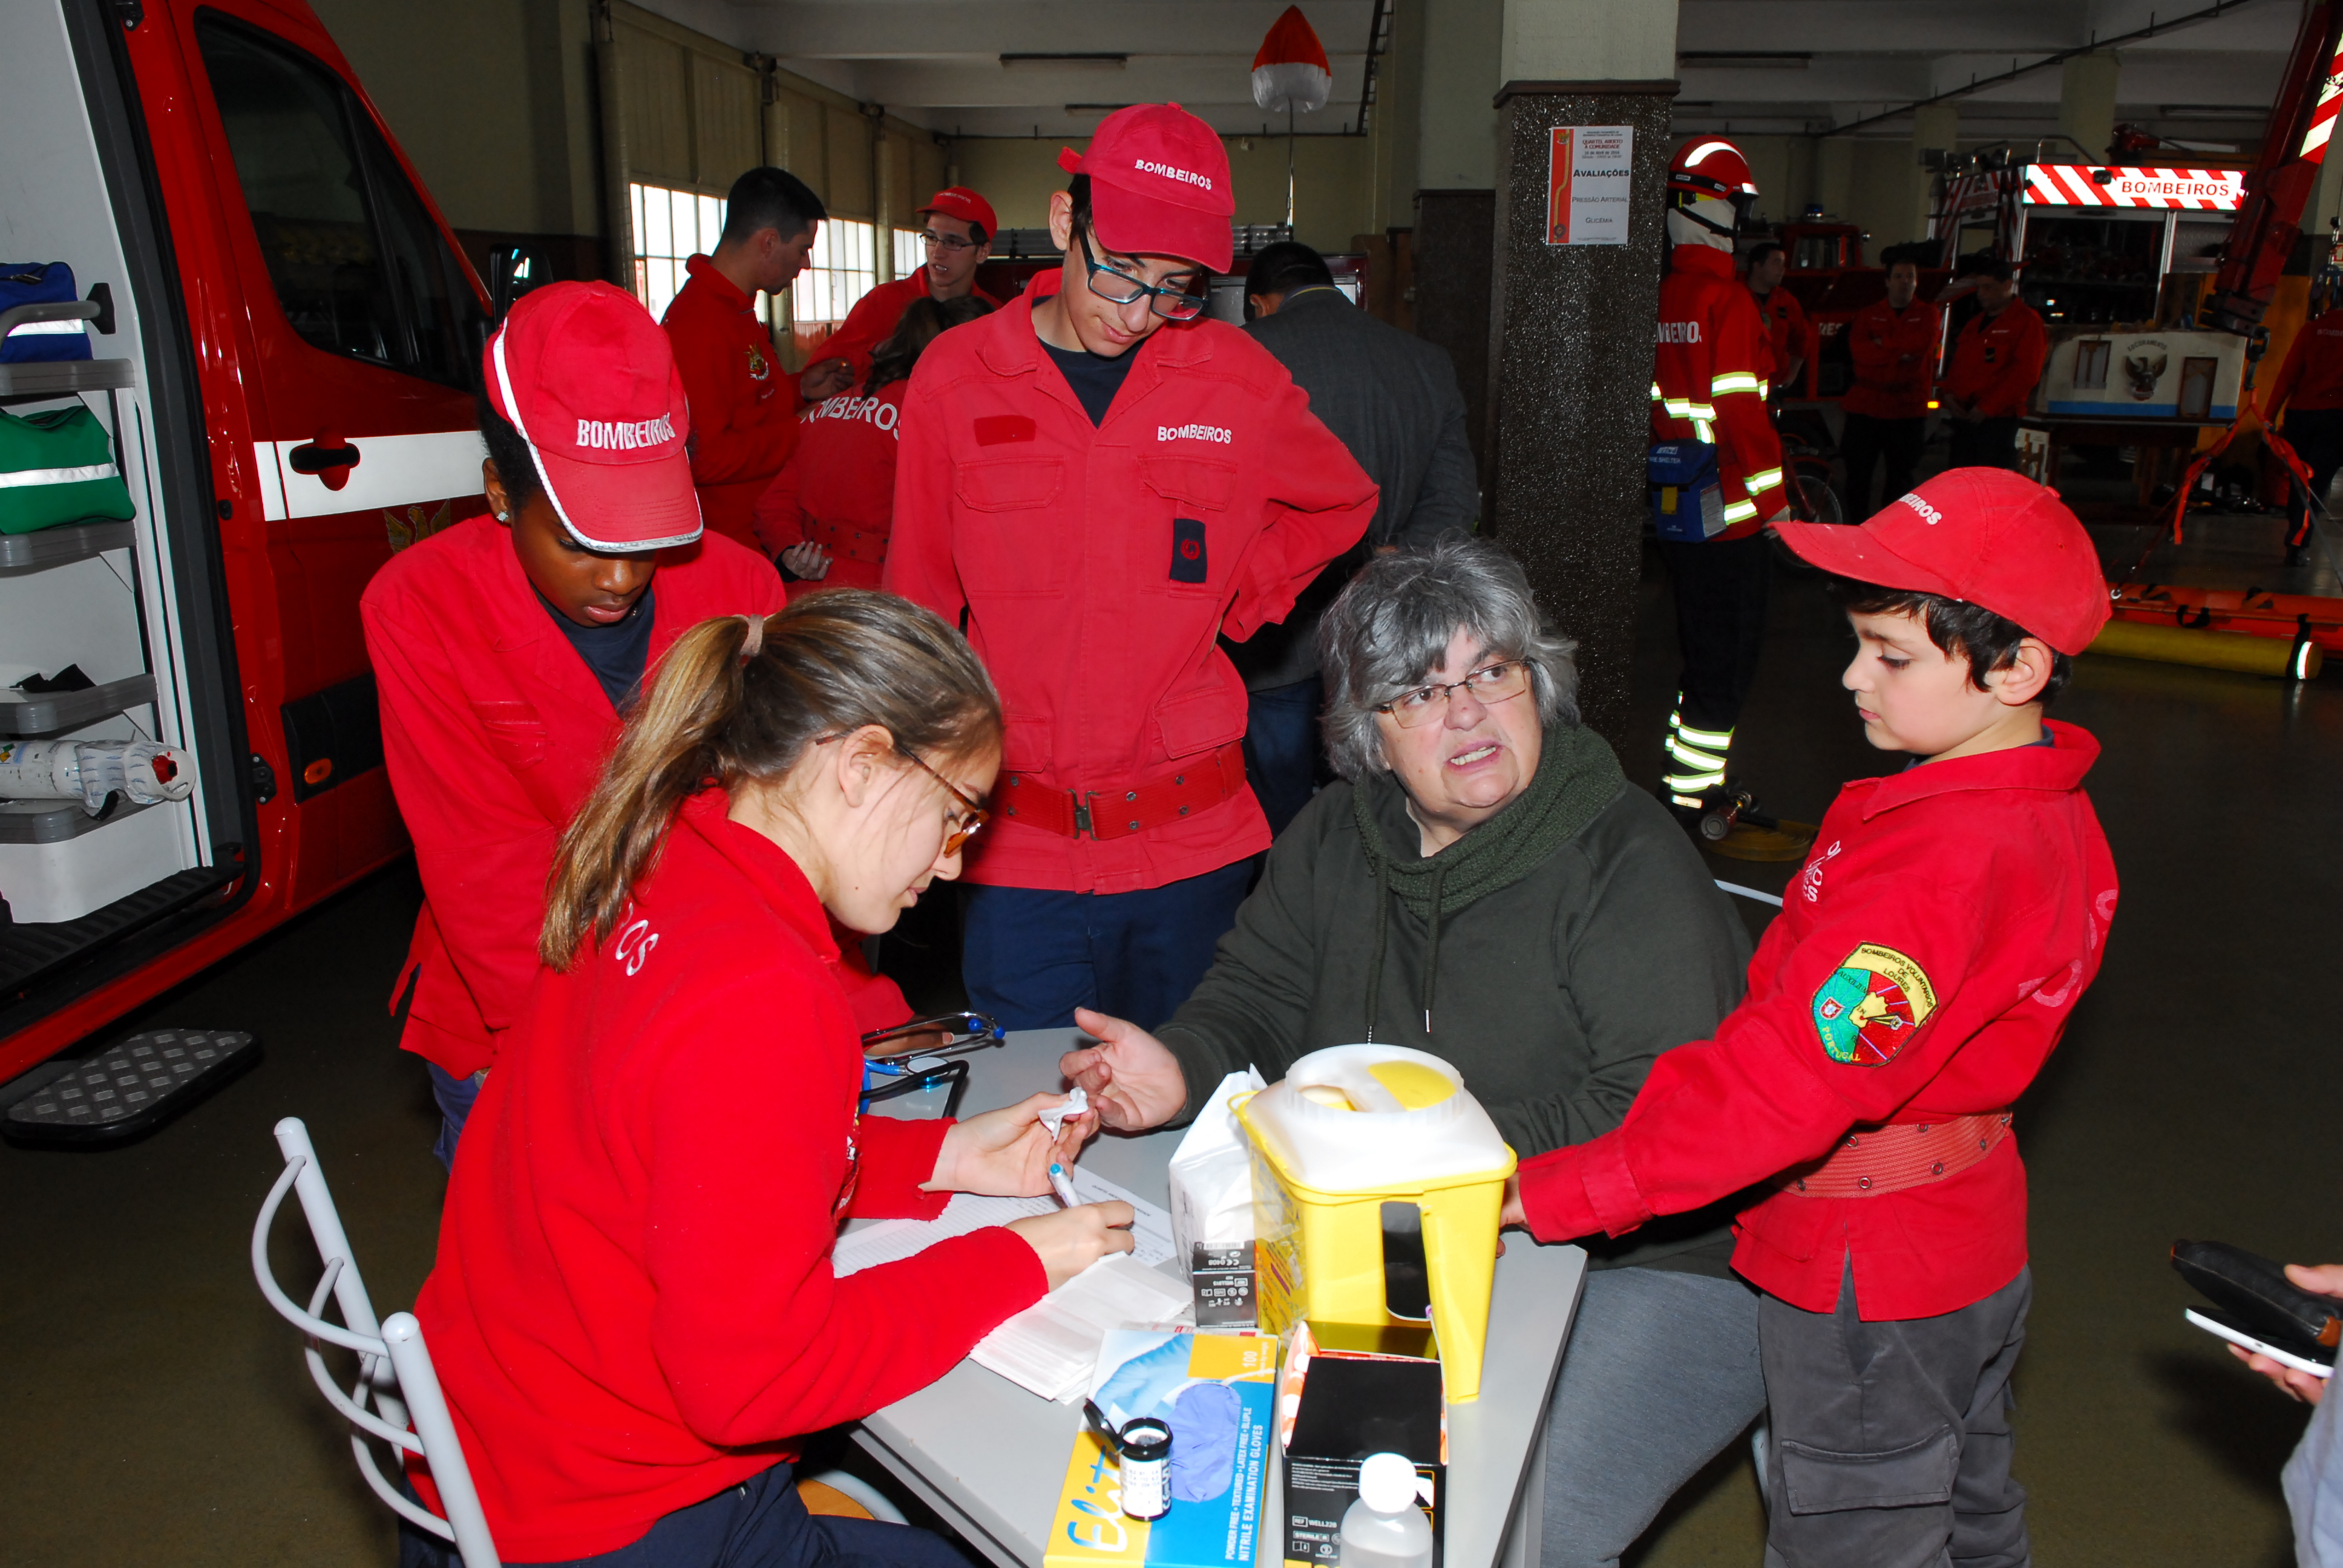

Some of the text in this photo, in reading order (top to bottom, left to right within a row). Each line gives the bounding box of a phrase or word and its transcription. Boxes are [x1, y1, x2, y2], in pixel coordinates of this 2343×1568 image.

[1135, 159, 1212, 190] BOMBEIROS
[2122, 181, 2229, 196] BOMBEIROS
[576, 413, 675, 449] BOMBEIROS
[1157, 423, 1232, 445] BOMBEIROS
[1861, 948, 1906, 966] BOMBEIROS
[1883, 968, 1910, 992] LOURES
[1898, 968, 1907, 978] DE
[1821, 1026, 1861, 1062] PORTUGAL
[1242, 1351, 1257, 1367] 100
[1225, 1407, 1253, 1560] POWDER FREE TEXTURED LATEX FREE BLUPLE
[1239, 1424, 1263, 1561] NITRILE EXAMINATION GLOVES
[1067, 1445, 1129, 1552] Elit
